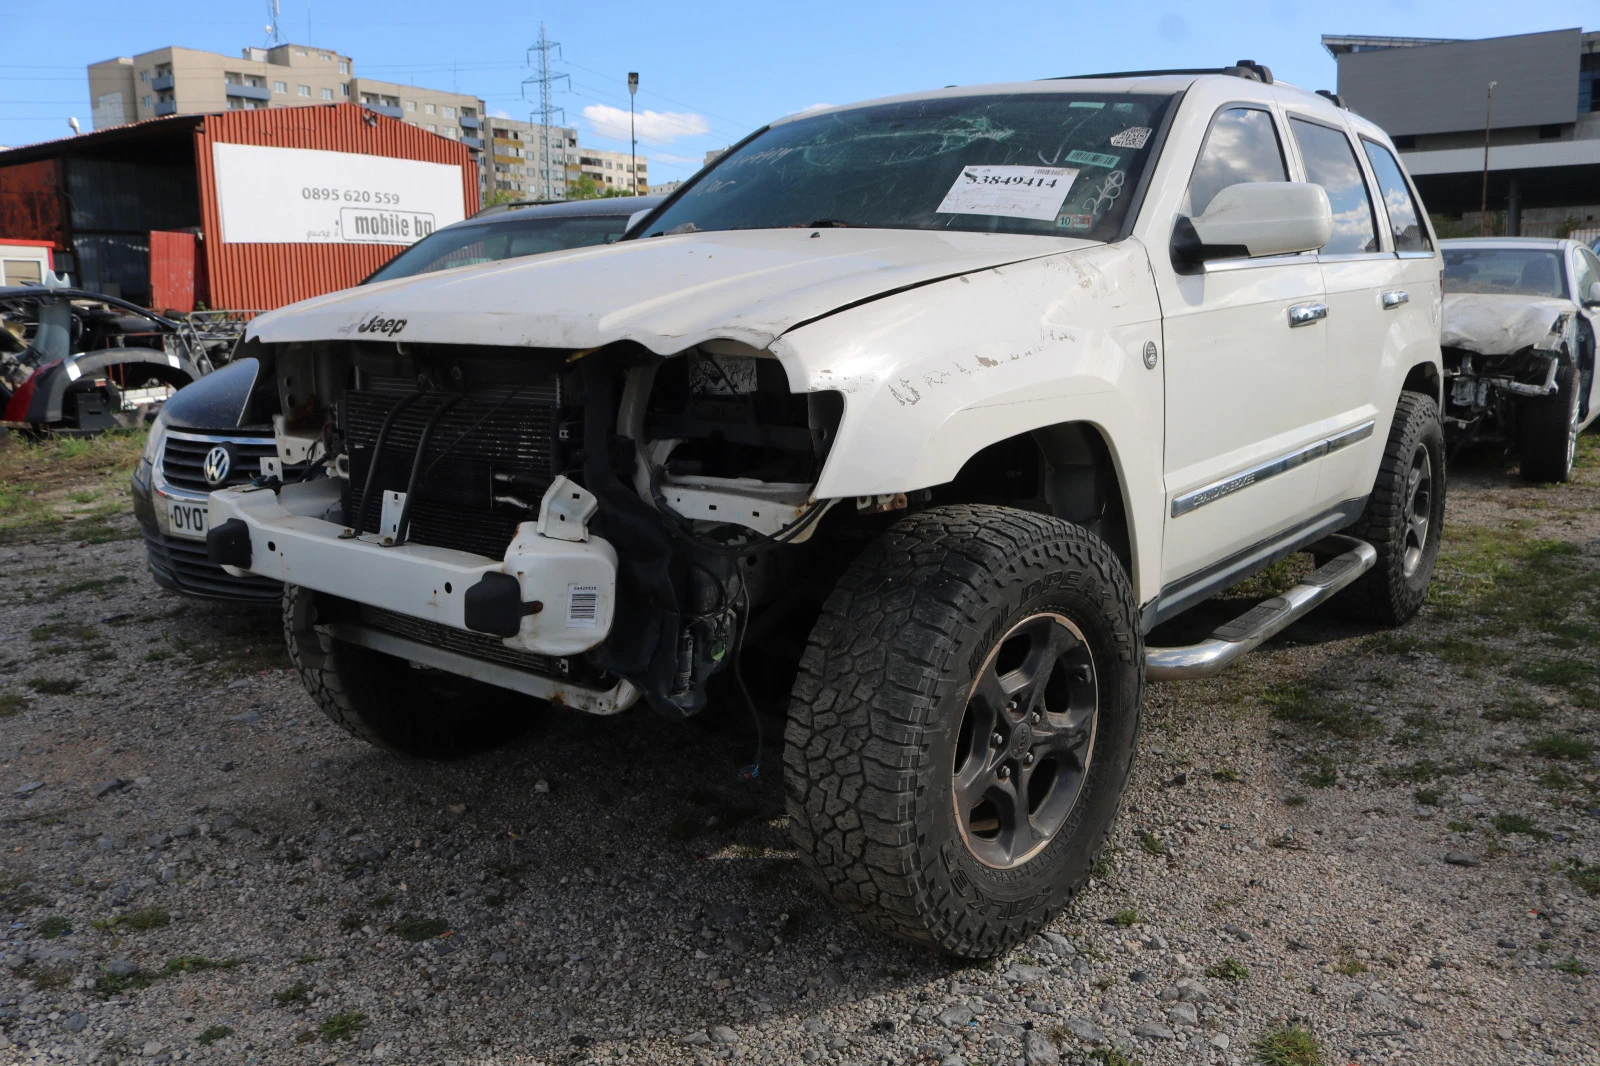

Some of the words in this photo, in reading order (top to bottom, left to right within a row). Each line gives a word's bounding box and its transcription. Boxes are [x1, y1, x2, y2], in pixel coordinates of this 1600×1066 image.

[302, 187, 340, 201] 0895
[343, 190, 370, 203] 620
[374, 192, 400, 205] 559
[354, 213, 409, 238] mobile
[1059, 216, 1071, 226] 10
[357, 315, 408, 337] Jeep
[1193, 489, 1220, 505] GRAND
[1220, 474, 1255, 494] CHEROKEE
